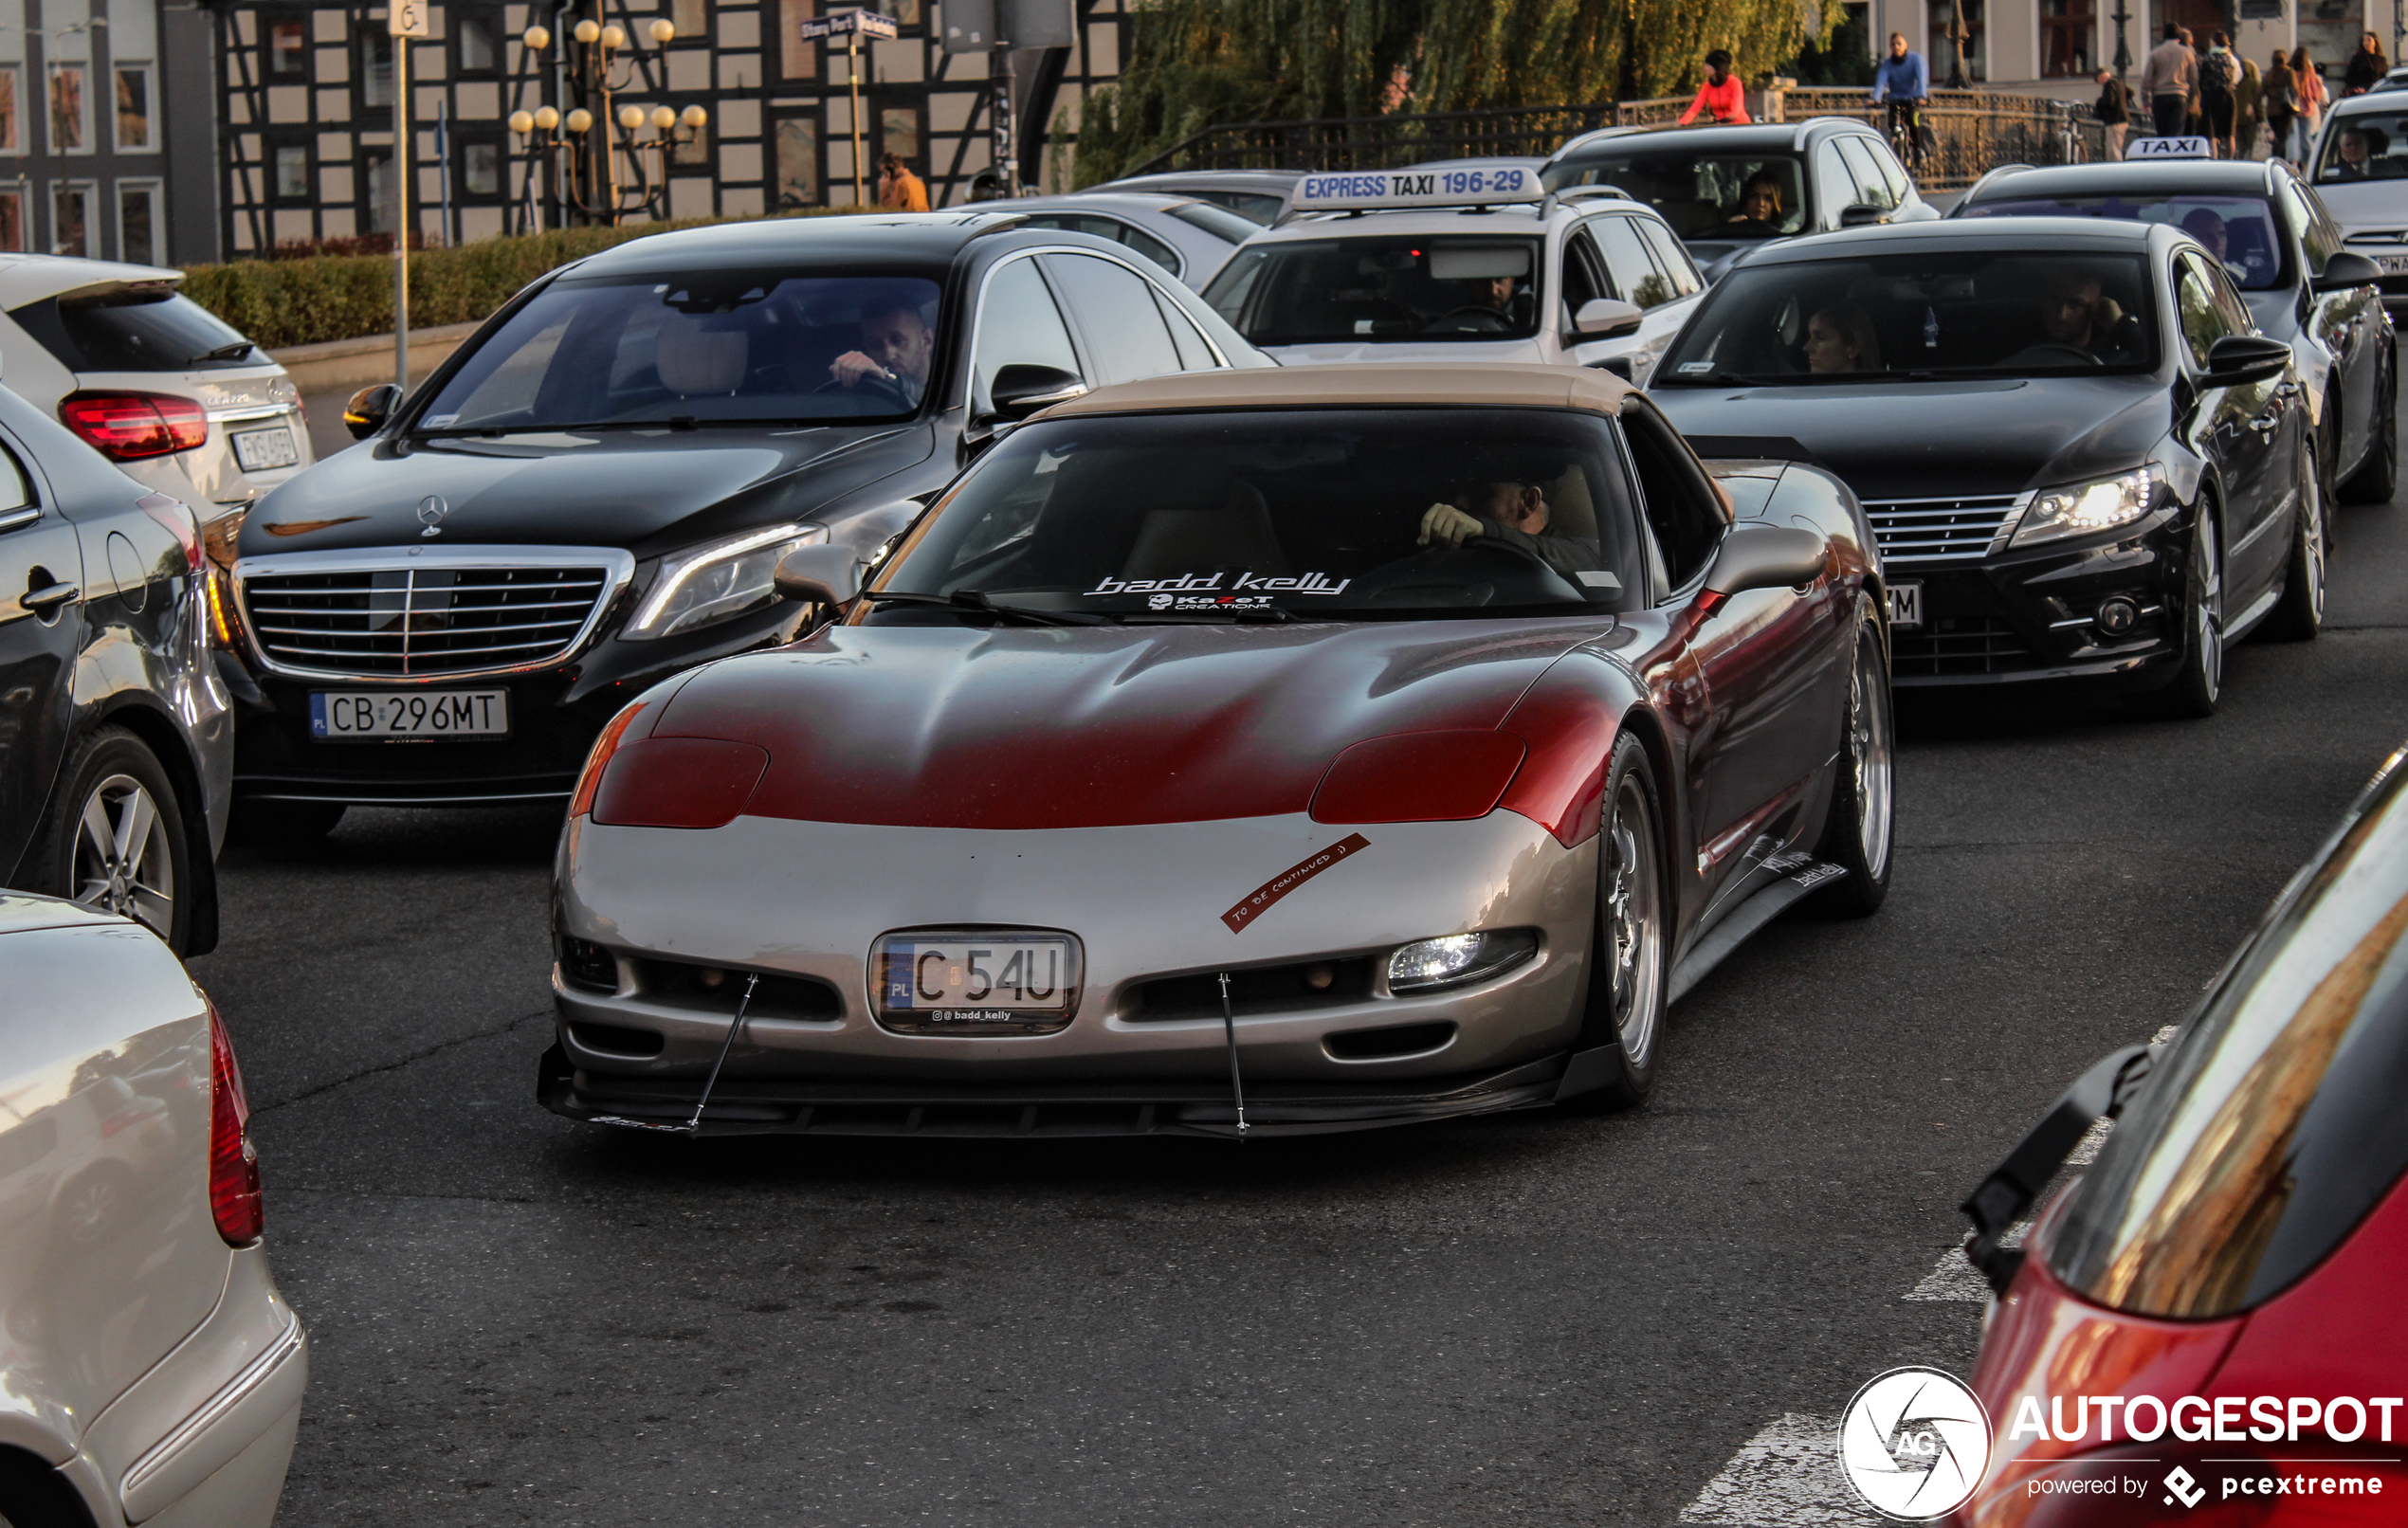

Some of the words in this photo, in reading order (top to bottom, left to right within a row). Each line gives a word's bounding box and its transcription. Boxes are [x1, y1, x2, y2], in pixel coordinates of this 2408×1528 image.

[830, 16, 853, 32] Port
[2141, 139, 2198, 154] TAXI
[1304, 175, 1386, 198] EXPRESS
[1392, 174, 1435, 196] TAXI
[1442, 170, 1523, 194] 196-29
[1083, 572, 1223, 595] badd
[1232, 572, 1351, 595] kelly
[333, 697, 374, 732] CB
[388, 695, 496, 732] 296MT
[314, 719, 325, 729] PL
[1232, 907, 1248, 921] TO
[1251, 890, 1268, 905] BE
[1272, 854, 1330, 892] CONTINUED
[917, 950, 946, 1001] C
[965, 949, 1056, 1001] 54U
[891, 983, 910, 997] PL
[955, 1010, 1011, 1021] badd_kelly
